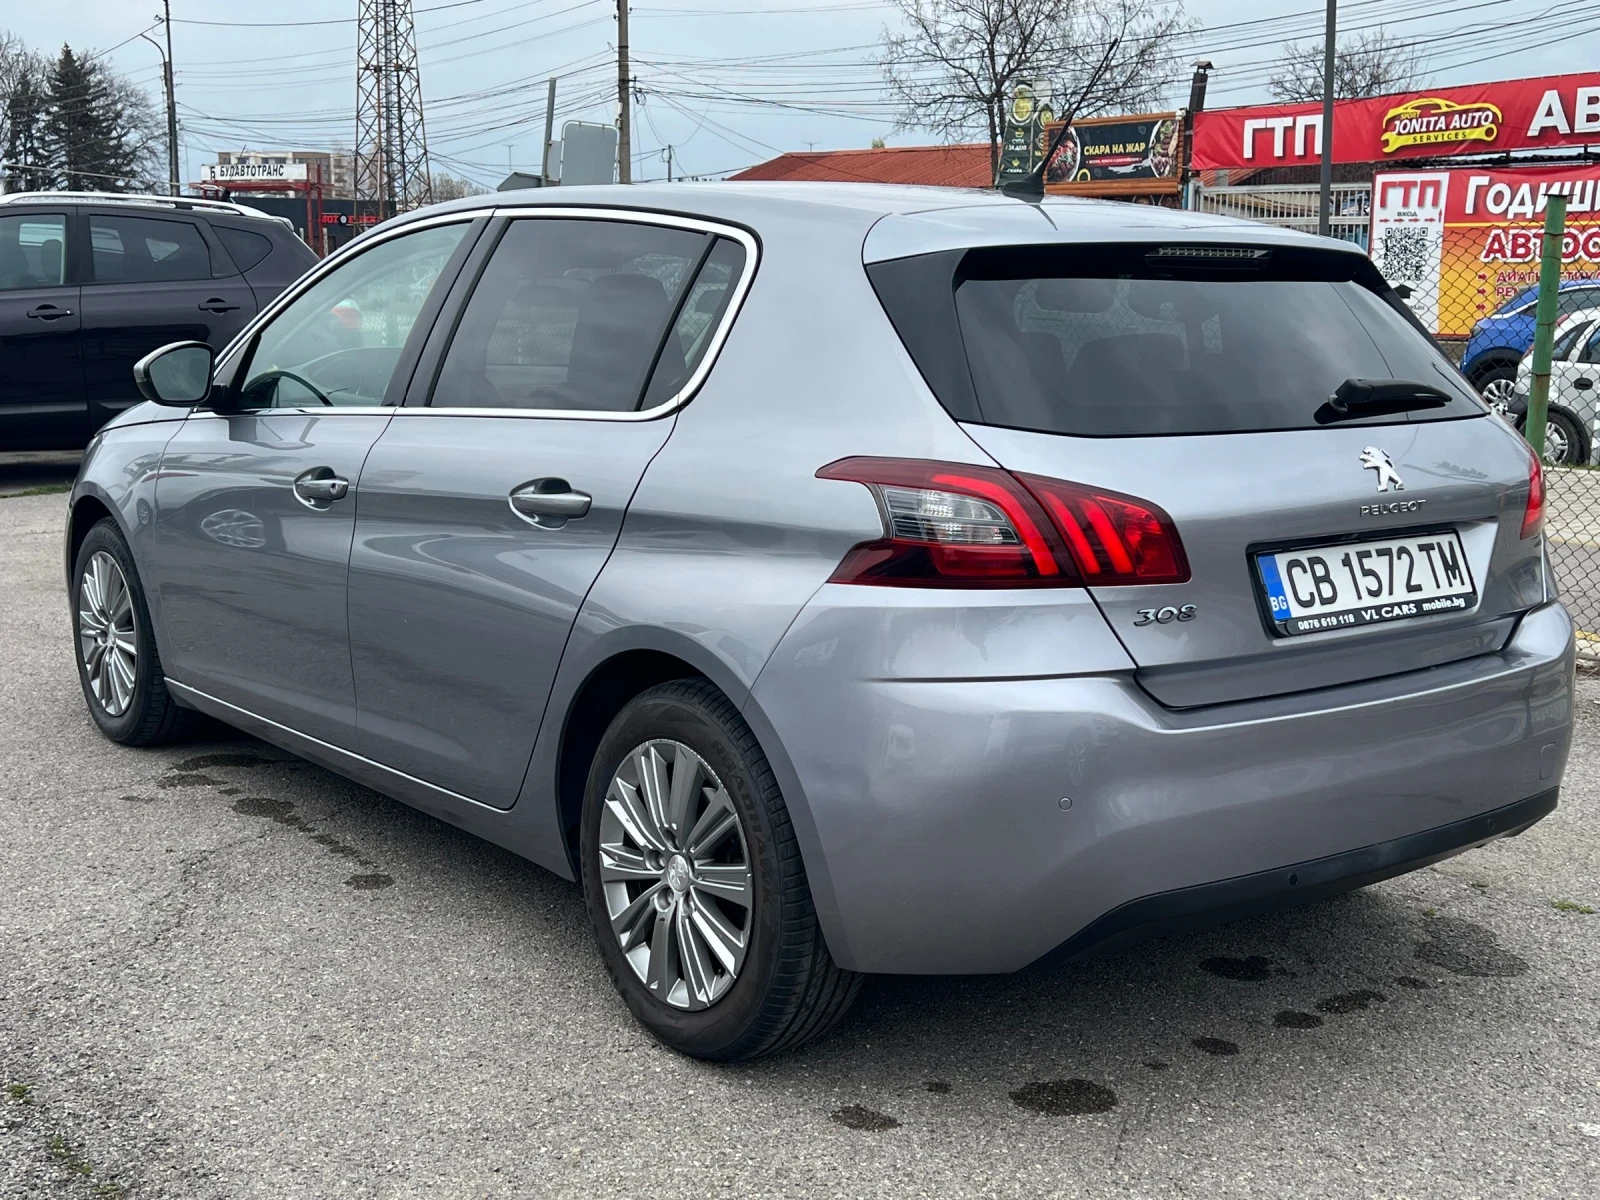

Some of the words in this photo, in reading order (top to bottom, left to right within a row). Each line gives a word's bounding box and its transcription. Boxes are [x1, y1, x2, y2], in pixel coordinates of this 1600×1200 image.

[1392, 116, 1446, 135] JONITA
[1450, 111, 1493, 129] AUTO
[1243, 114, 1324, 159] ГТП
[1412, 131, 1468, 143] SERVICES
[1084, 145, 1111, 155] СКАРА
[1112, 143, 1124, 153] НА
[1126, 142, 1146, 153] ЖАР
[1380, 180, 1441, 208] ГТП
[1360, 500, 1426, 517] PEUGEOT
[1286, 556, 1338, 608] CB
[1341, 545, 1423, 600] 1572
[1417, 540, 1466, 589] TM
[1133, 603, 1197, 626] 308
[1269, 596, 1287, 611] BG
[1298, 617, 1320, 630] 0876
[1321, 616, 1338, 627] 619
[1338, 614, 1355, 625] 118
[1361, 608, 1380, 621] VL
[1381, 603, 1417, 618] CARS
[1422, 595, 1466, 611] mobile.bg
